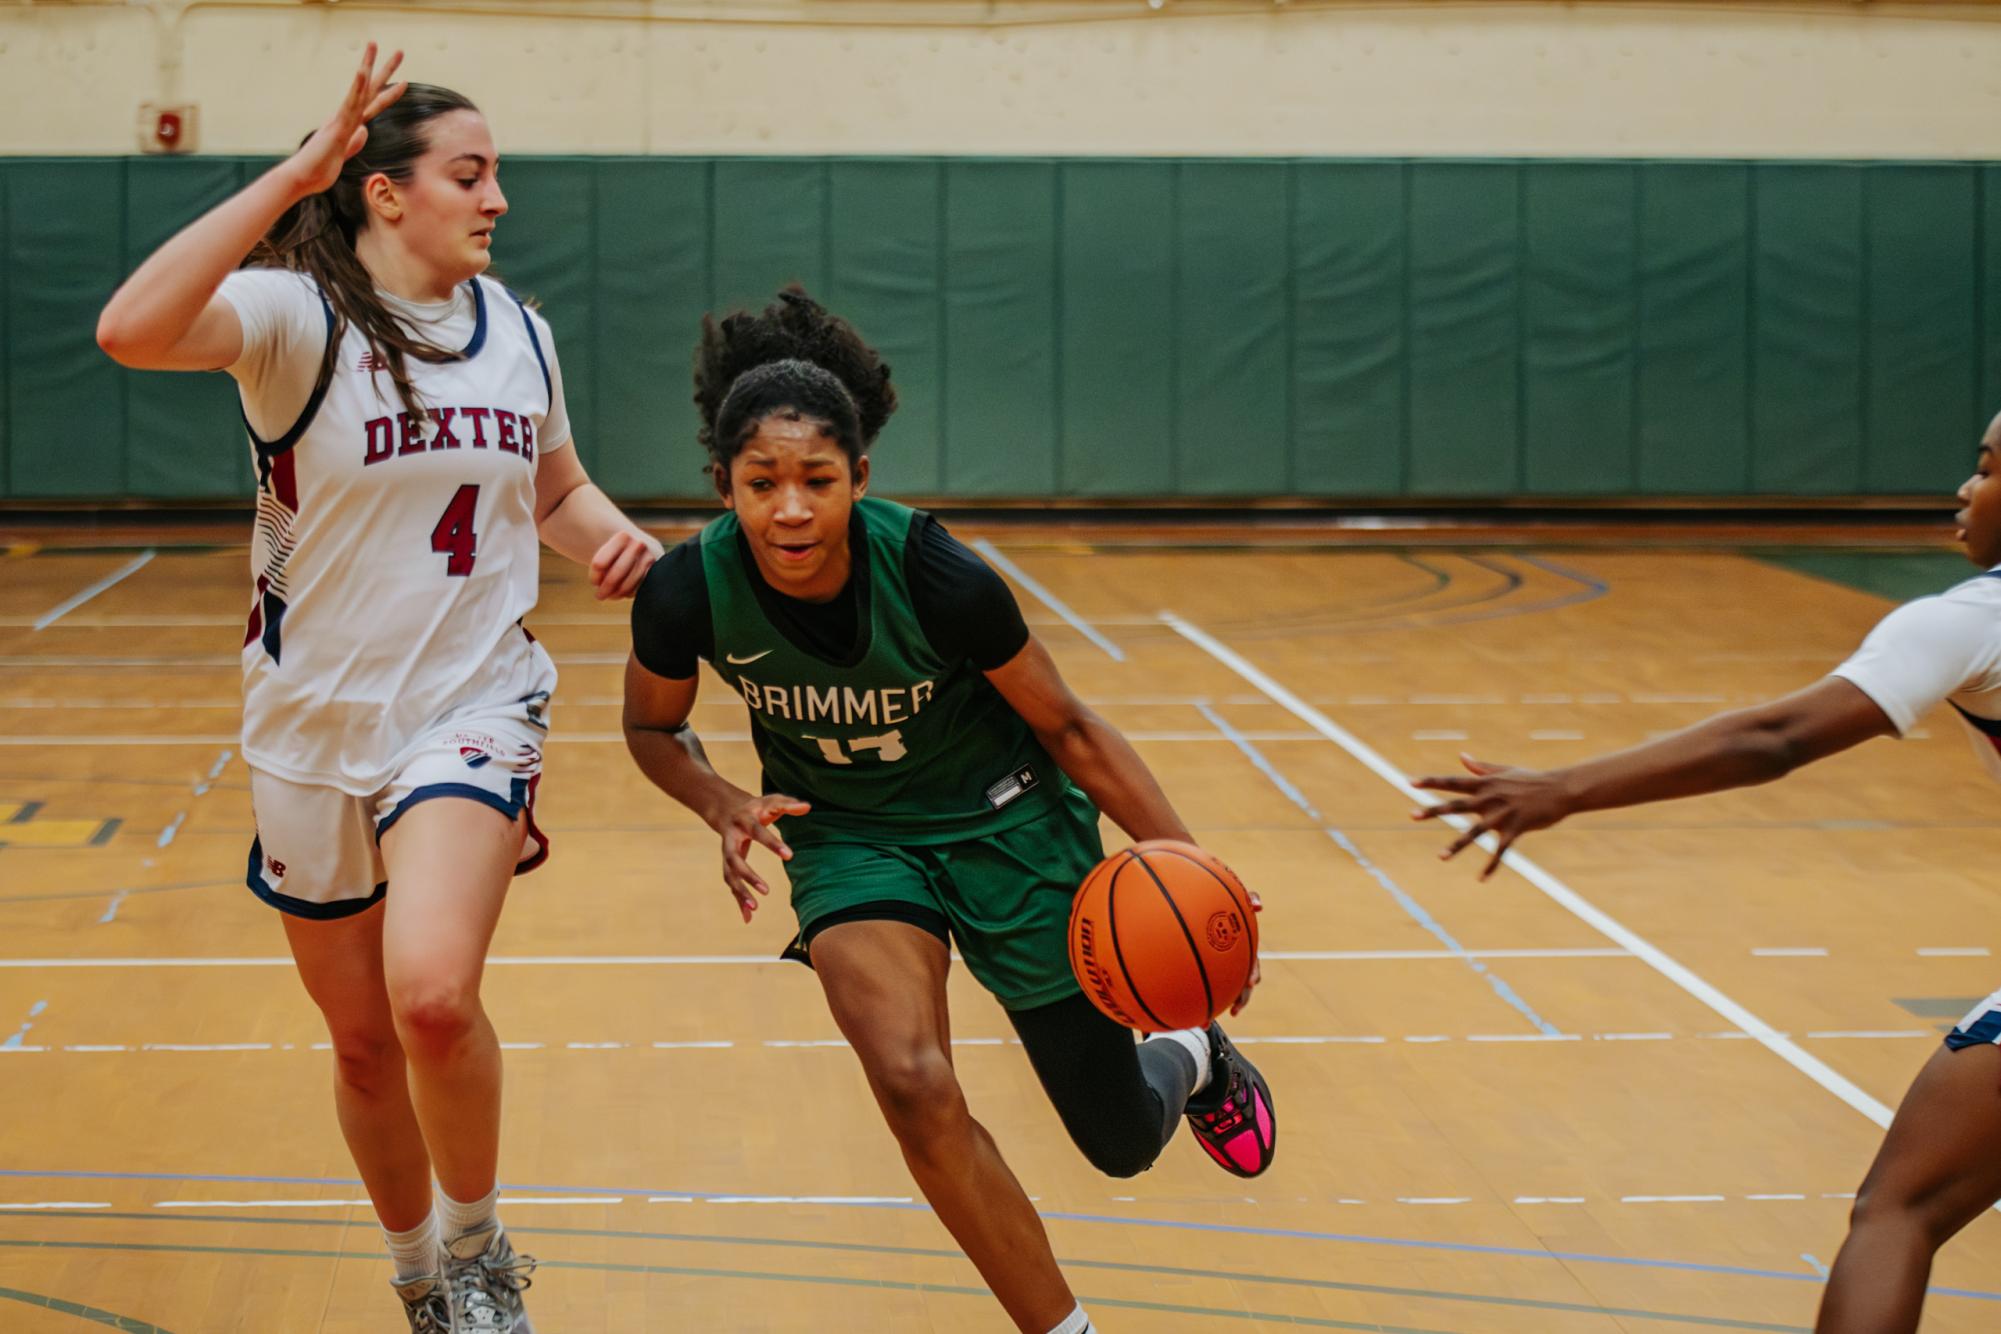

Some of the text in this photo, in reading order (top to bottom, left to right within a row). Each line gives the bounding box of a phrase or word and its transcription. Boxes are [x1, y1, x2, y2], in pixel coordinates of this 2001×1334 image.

[364, 406, 533, 466] DEXTER
[431, 484, 480, 577] 4
[738, 675, 935, 726] BRIMMER
